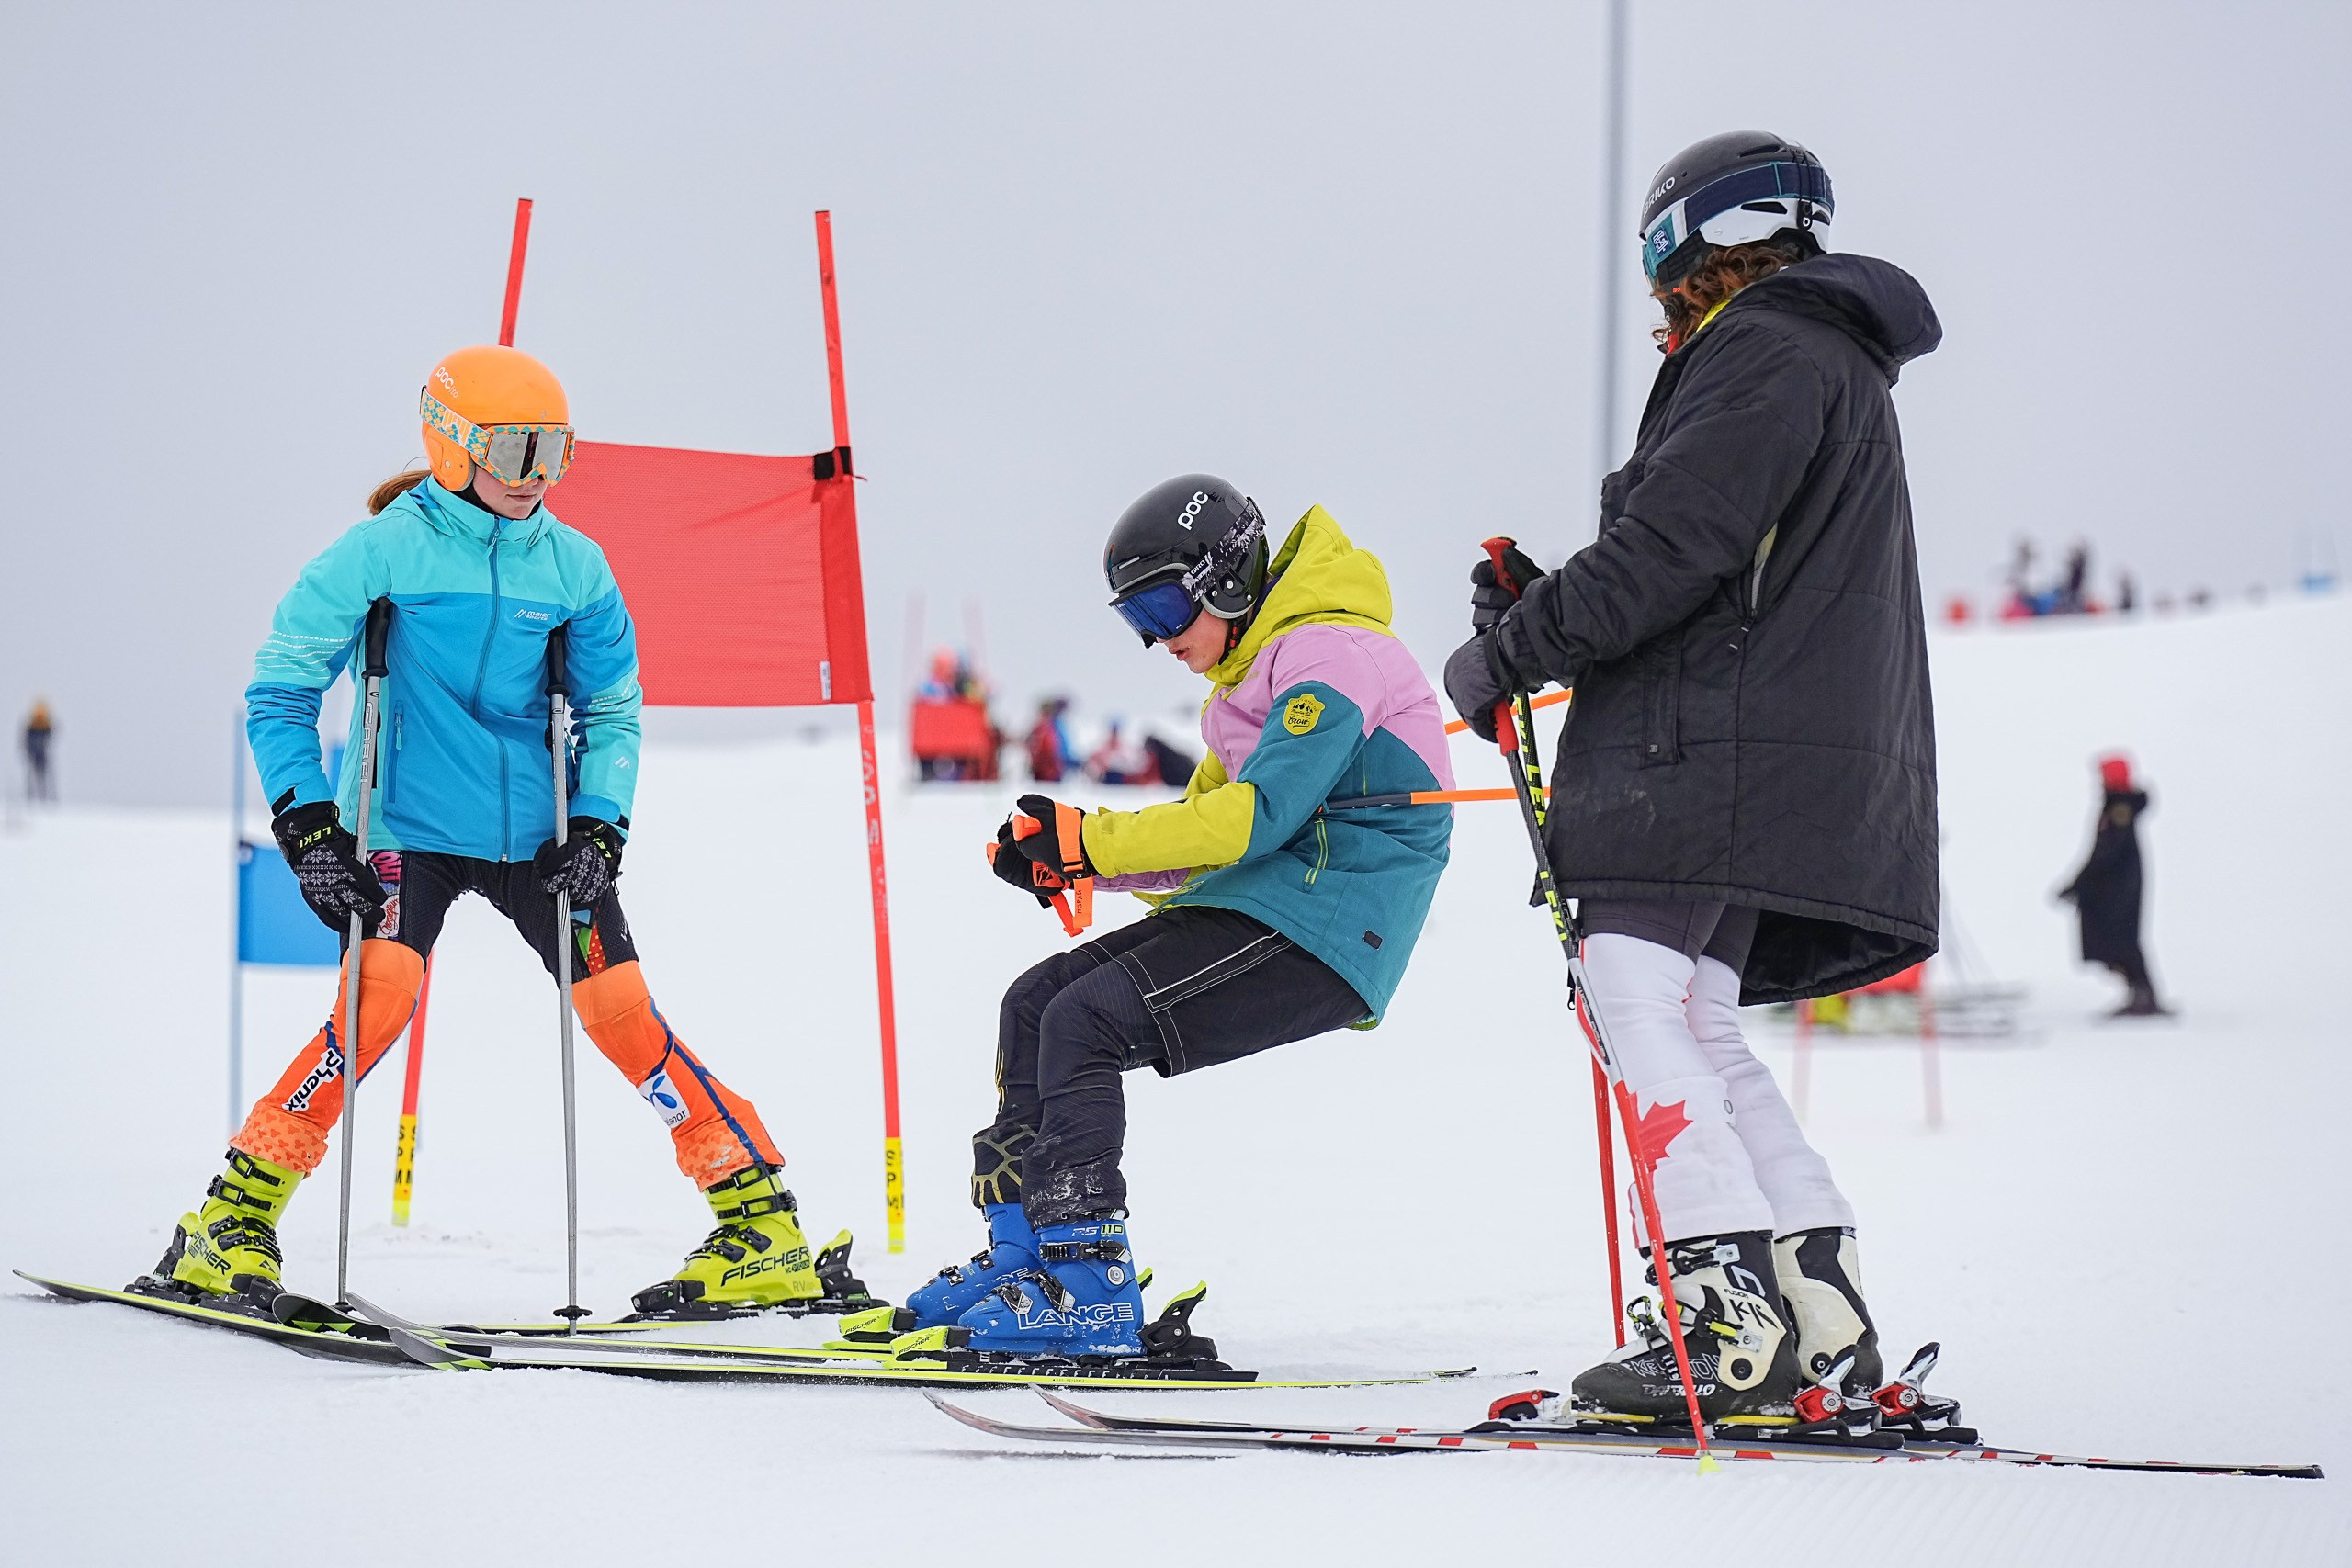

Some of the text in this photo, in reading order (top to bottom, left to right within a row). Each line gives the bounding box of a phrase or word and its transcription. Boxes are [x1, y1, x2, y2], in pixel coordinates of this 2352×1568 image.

[298, 825, 333, 850] LEKI
[284, 1049, 341, 1112] phenix
[1102, 1224, 1124, 1235] 110
[720, 1245, 810, 1287] FISCHER
[1017, 1303, 1134, 1330] LANGE
